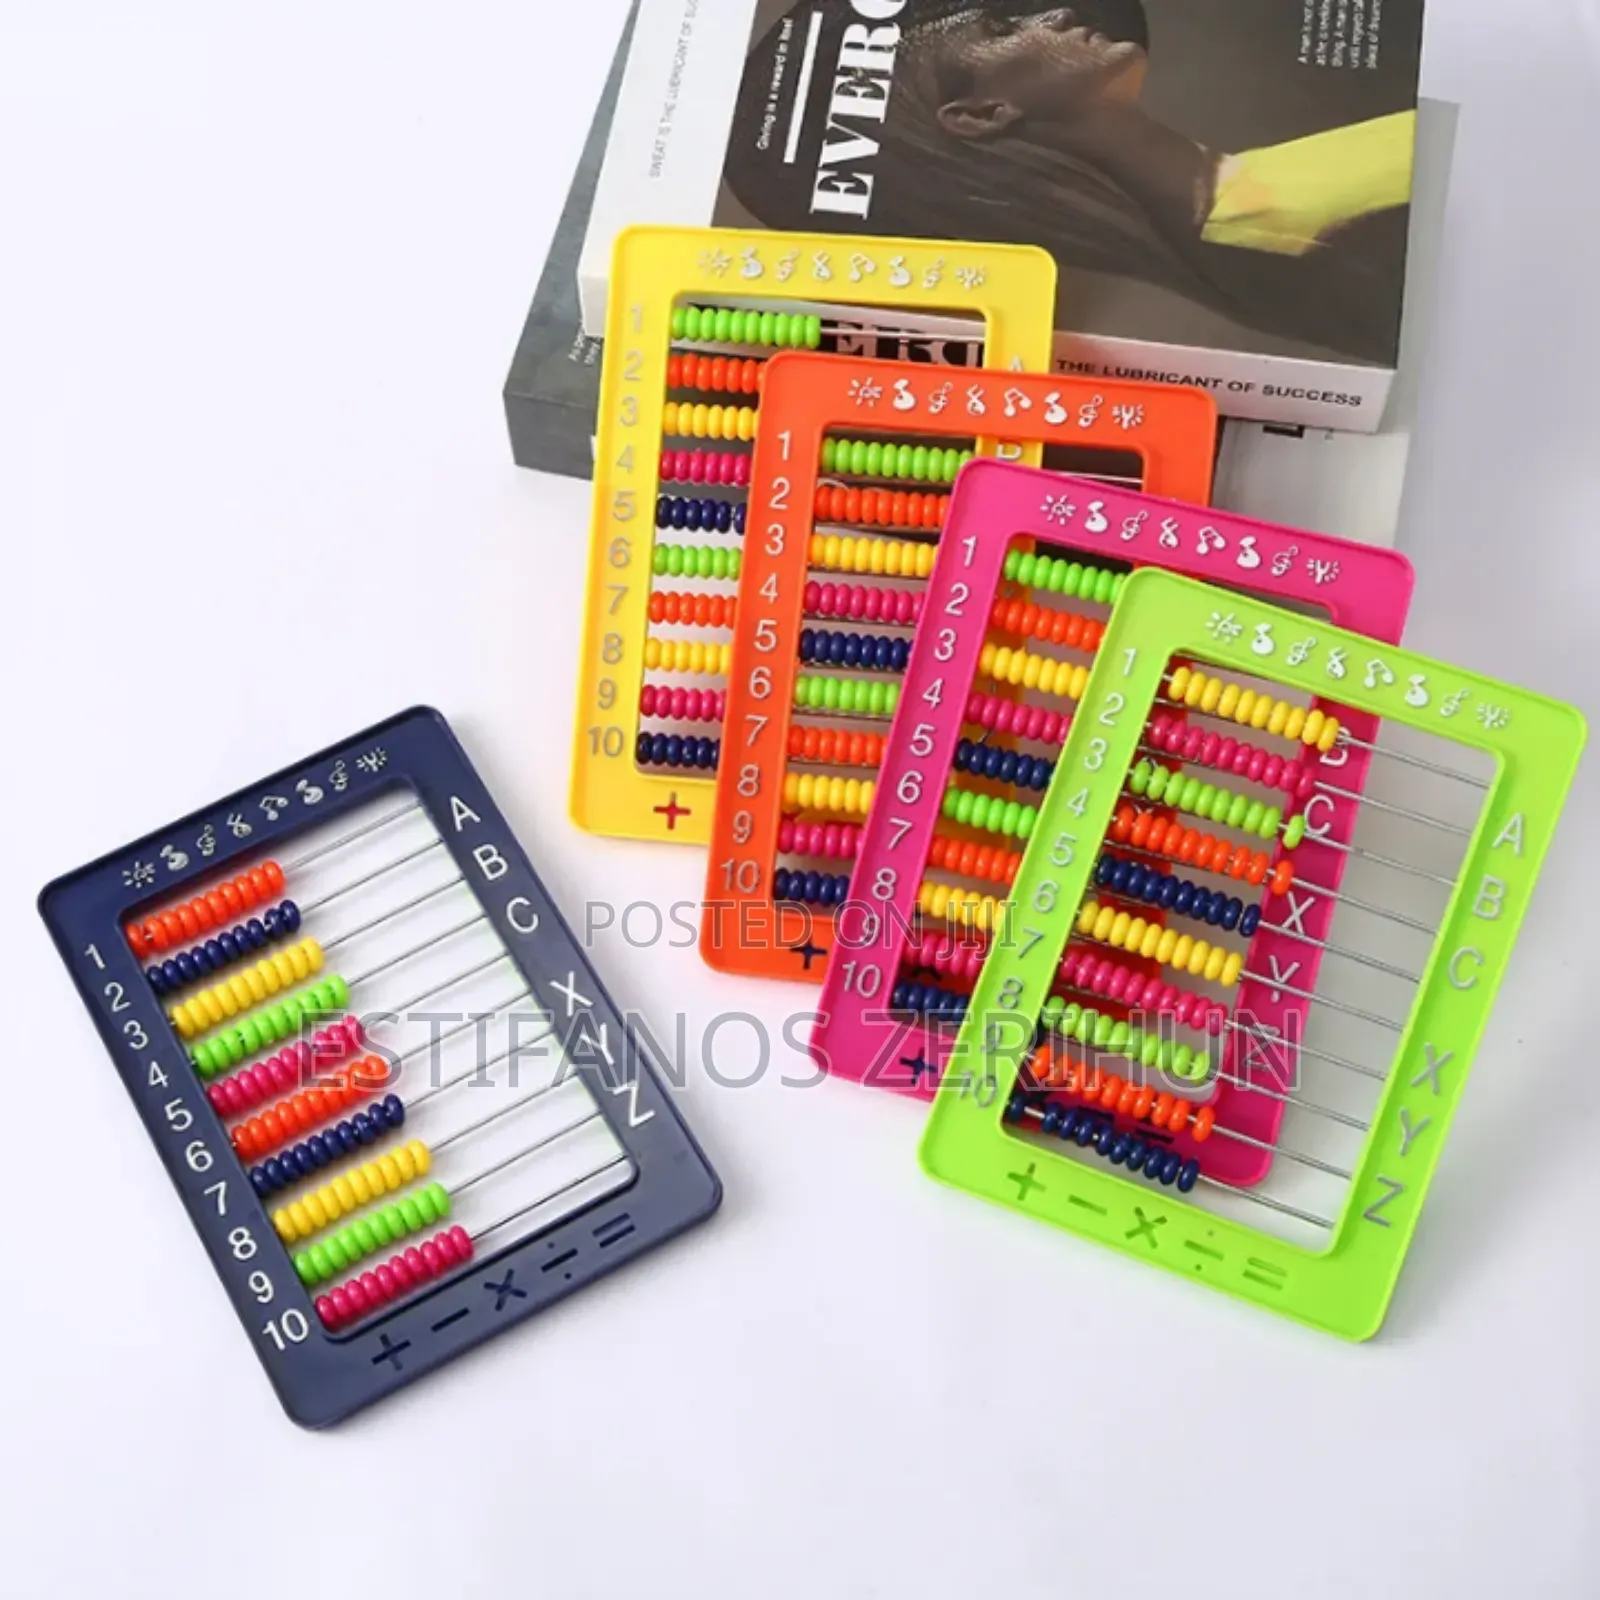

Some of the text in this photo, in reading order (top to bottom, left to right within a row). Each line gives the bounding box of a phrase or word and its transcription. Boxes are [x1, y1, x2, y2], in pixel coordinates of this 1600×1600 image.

[587, 303, 644, 758] 1 2 3 4 5 6 7 8 9 10
[1056, 359, 1363, 408] THE LUBRICANT OF SUCCESS
[720, 430, 792, 894] 1 2 3 4 5 6 7 8 9 10
[841, 535, 978, 998] 1 2 3 4 5 6 7 8 9 10
[1304, 795, 1334, 836] C
[449, 794, 656, 1128] A B C X Y Z
[958, 647, 1138, 1109] 1 2 3 4 5 6 7 8 9 10
[1268, 954, 1300, 1003] Y
[1281, 891, 1315, 937] X
[1362, 812, 1526, 1228] A B C X Y Z
[84, 943, 311, 1353] 1 2 3 4 5 6 7 8 9 10
